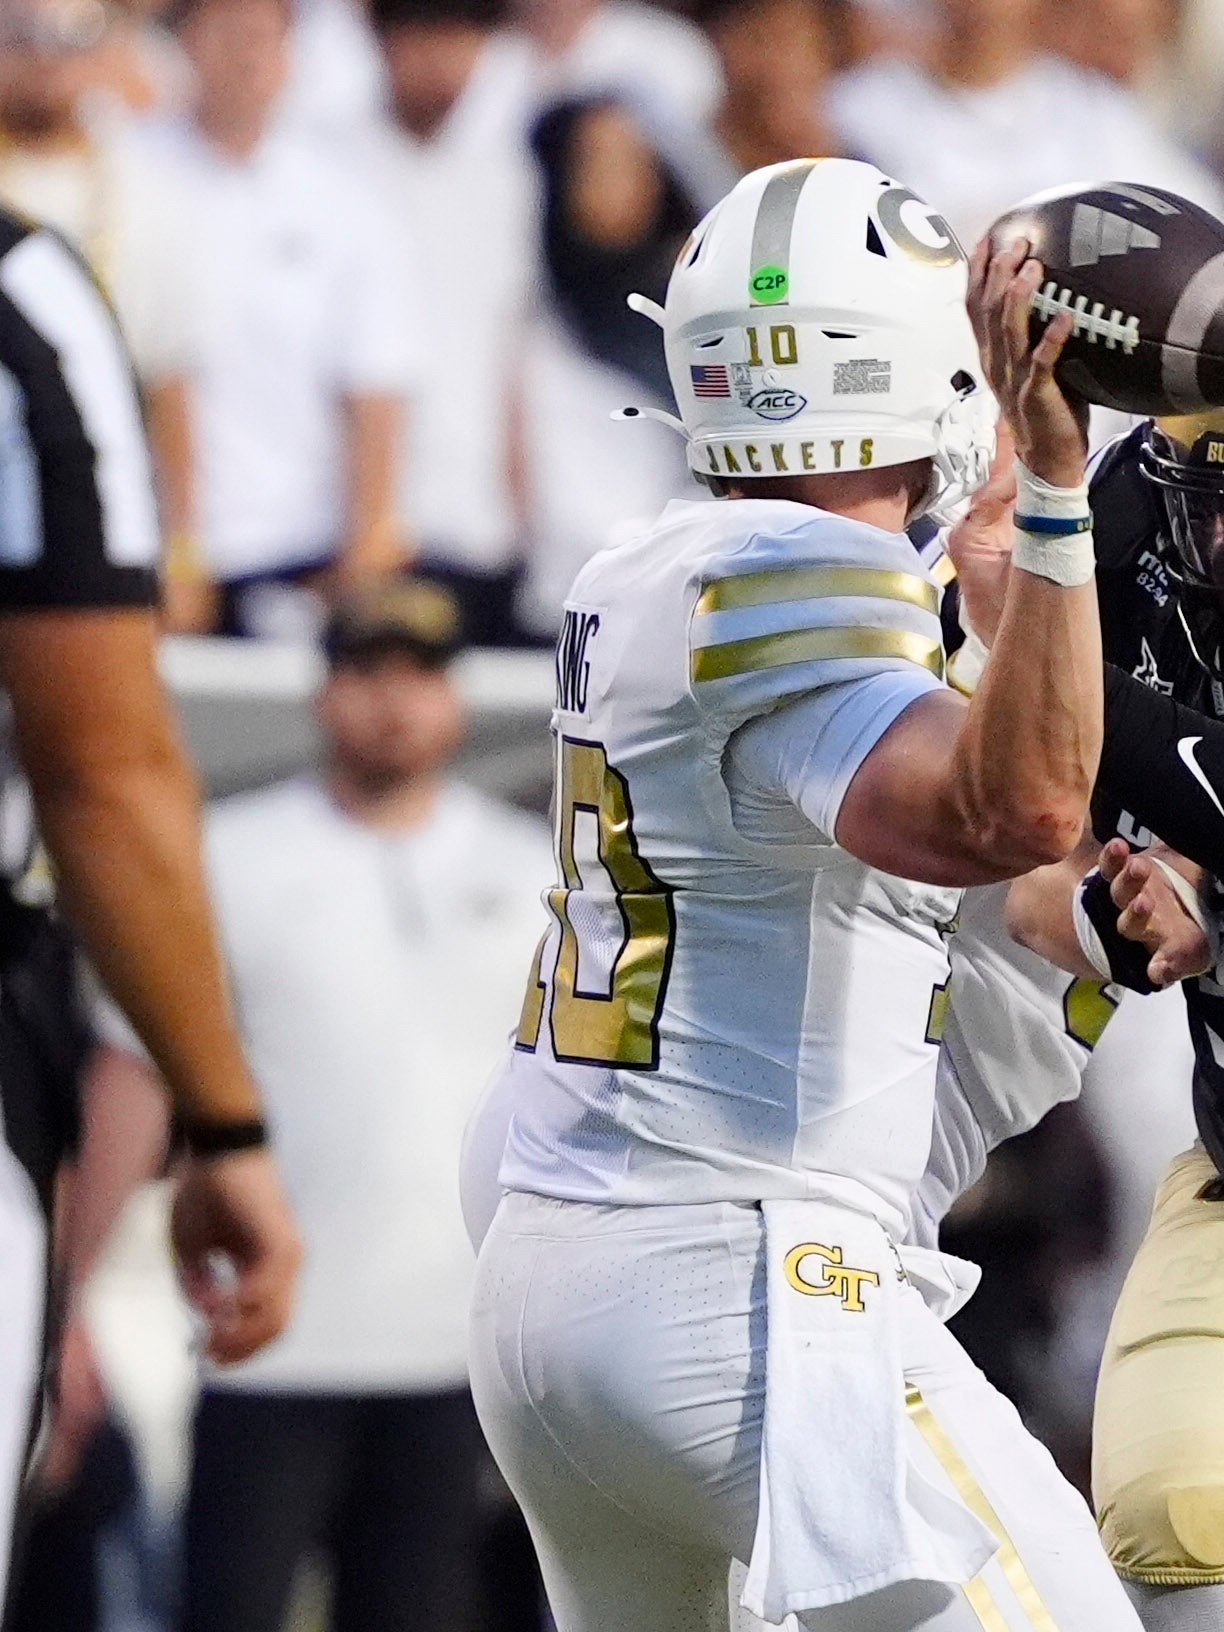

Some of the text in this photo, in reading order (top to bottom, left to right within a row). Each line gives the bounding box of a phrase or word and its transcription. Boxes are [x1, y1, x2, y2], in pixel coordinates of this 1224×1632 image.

[753, 275, 785, 291] C2P
[746, 325, 799, 367] 10
[757, 395, 796, 408] ACC
[706, 438, 874, 473] JACKETS
[784, 1242, 880, 1312] GT
